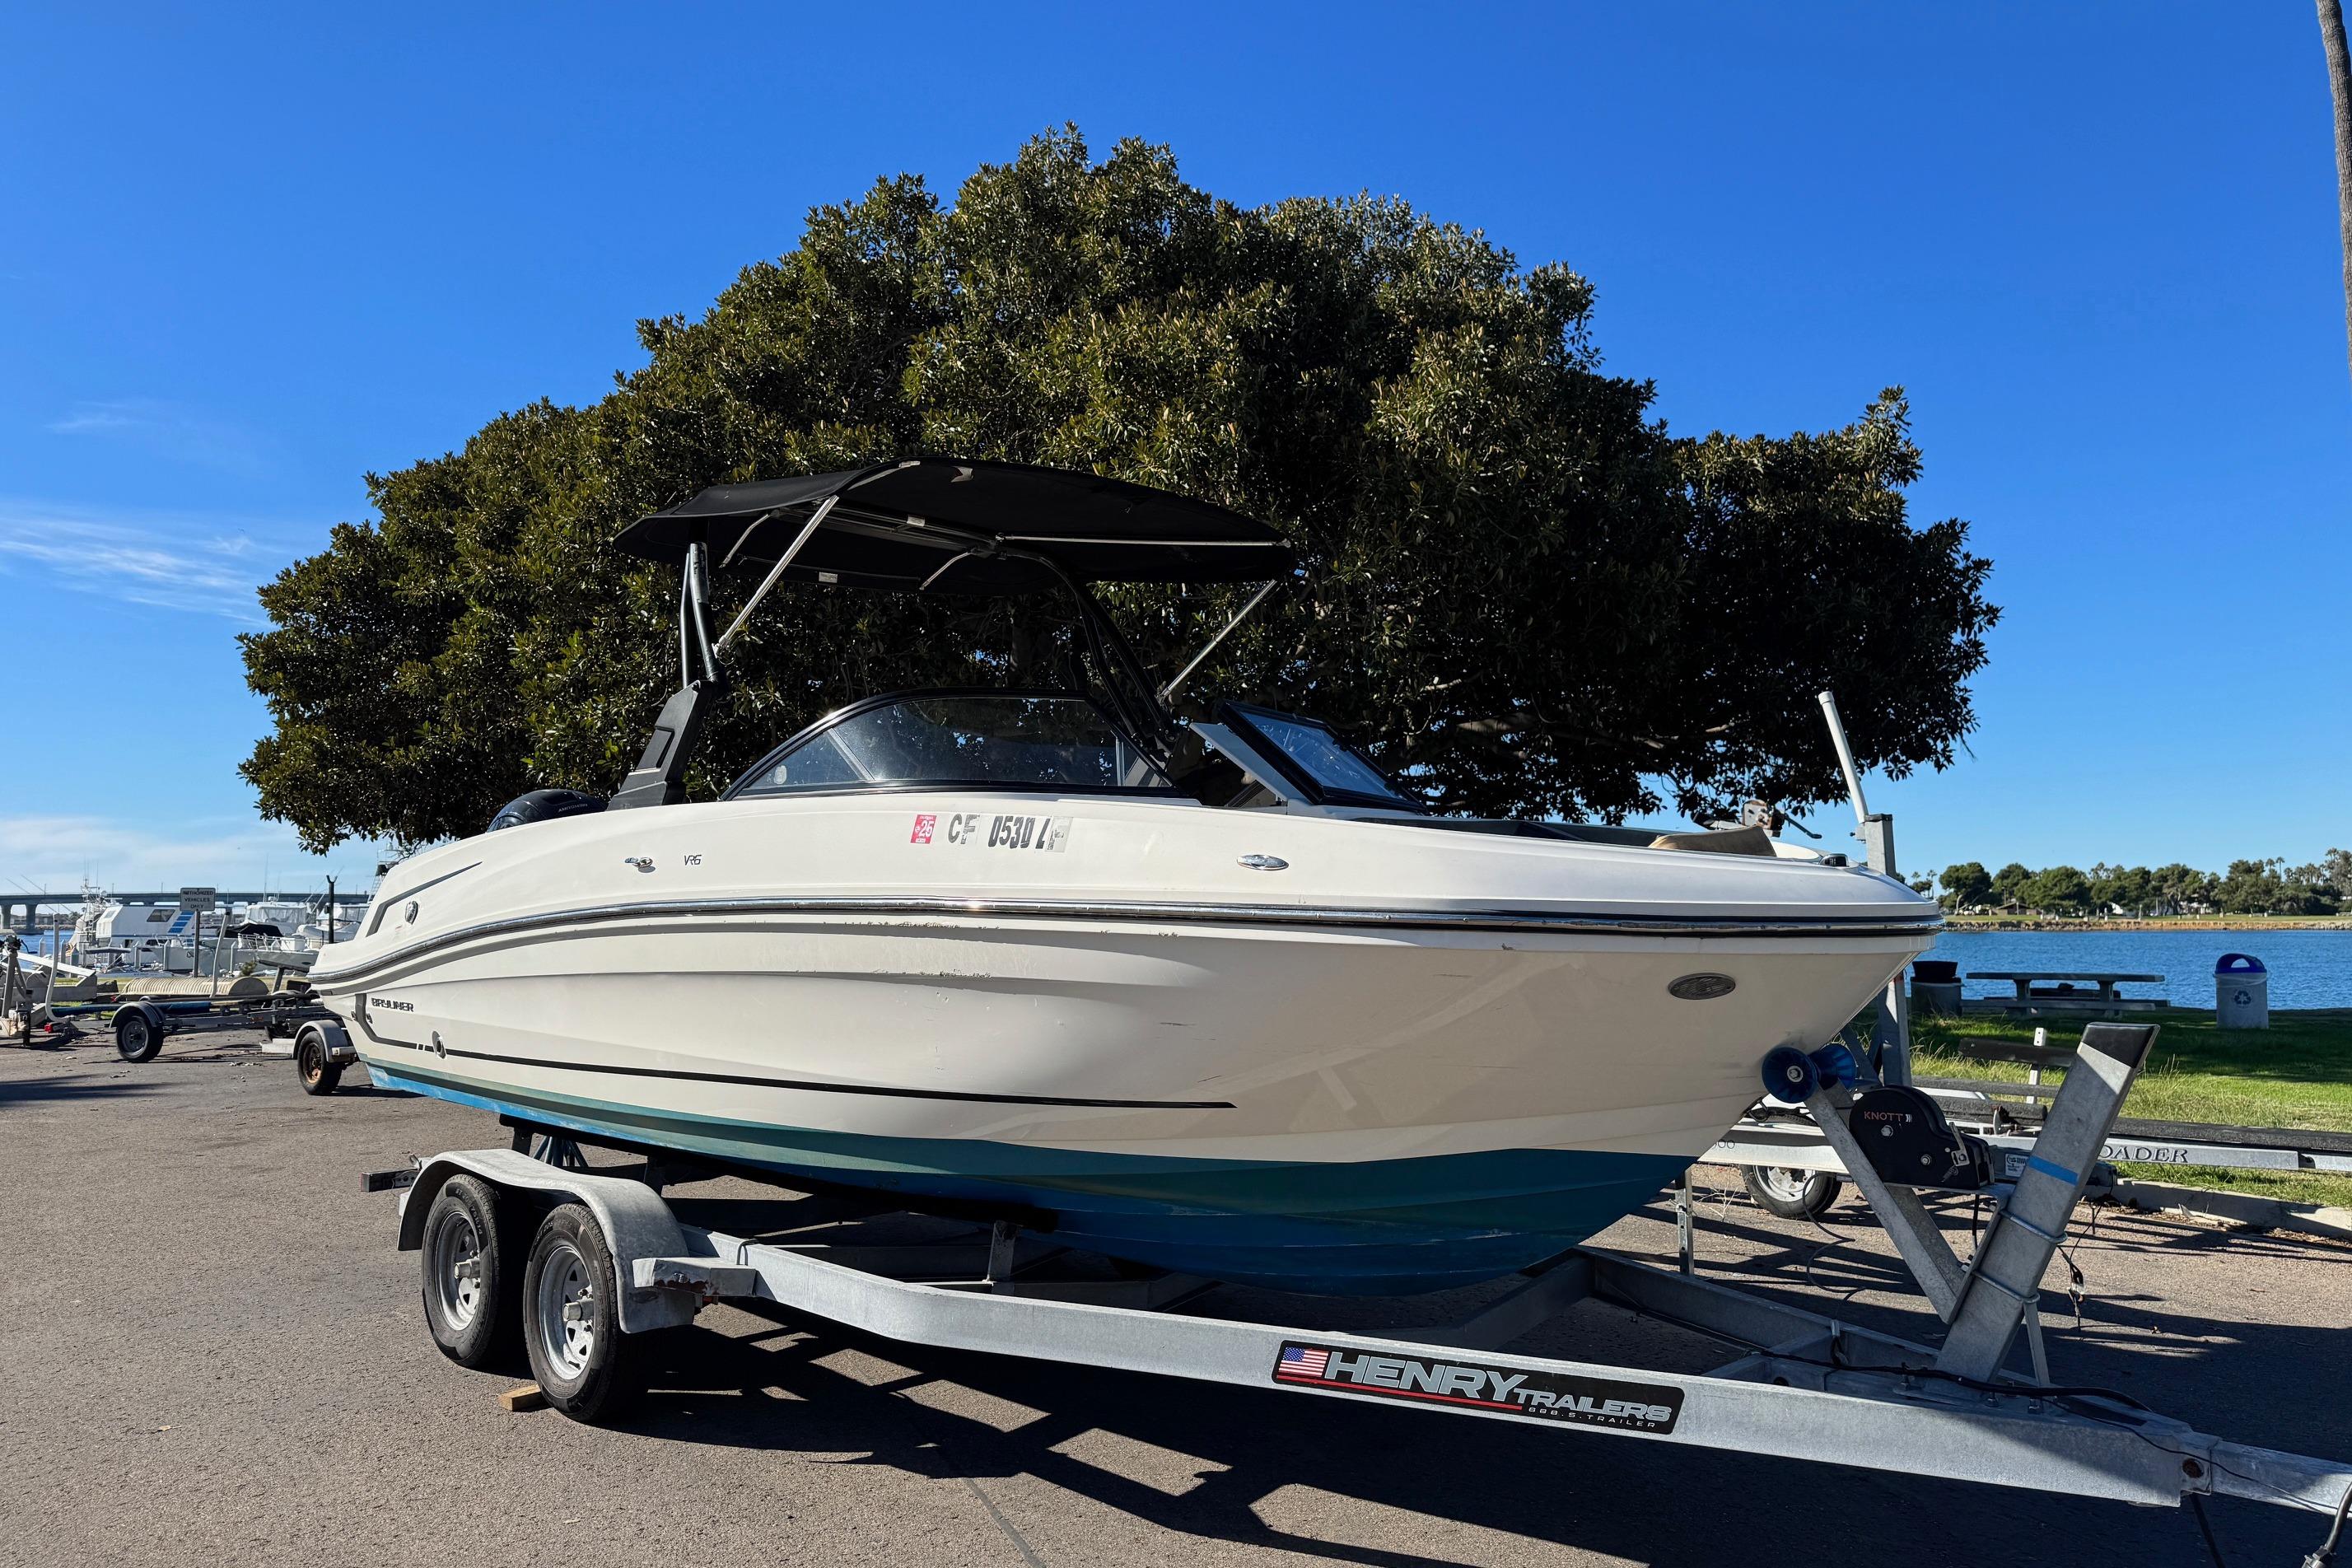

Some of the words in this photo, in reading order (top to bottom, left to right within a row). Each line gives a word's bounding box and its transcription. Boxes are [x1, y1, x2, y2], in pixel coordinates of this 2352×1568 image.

[918, 819, 935, 838] 25
[948, 813, 979, 844] CF
[988, 815, 1036, 849] 0530
[1864, 1111, 1903, 1122] KNOTT
[2098, 1145, 2189, 1164] OADER
[1323, 1351, 1529, 1402] HENRY
[1513, 1388, 1673, 1423] TRAILERS
